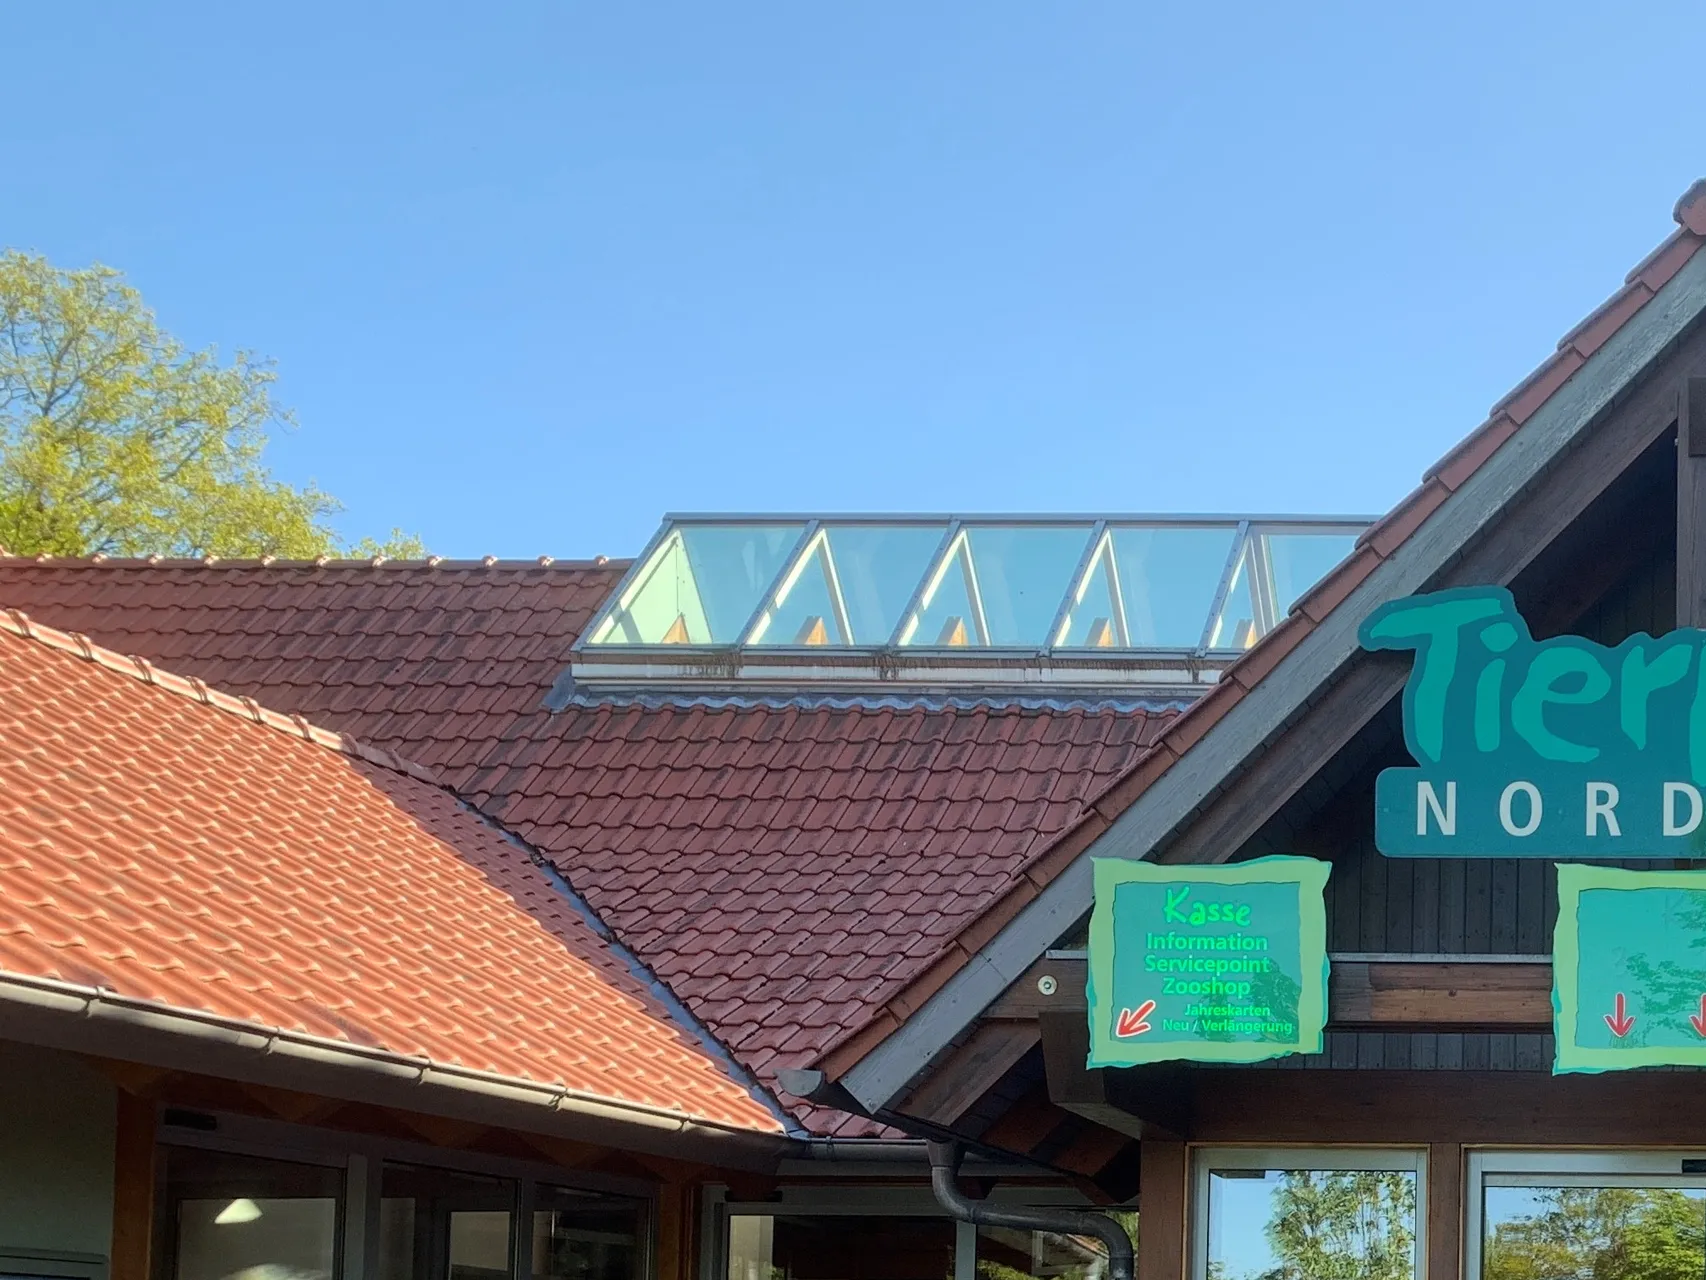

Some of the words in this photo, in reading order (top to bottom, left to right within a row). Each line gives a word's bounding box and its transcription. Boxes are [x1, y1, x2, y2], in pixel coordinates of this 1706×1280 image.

[1163, 886, 1251, 926] Kasse
[1146, 932, 1268, 951] Information
[1144, 954, 1270, 976] Servicepoint
[1162, 977, 1250, 999] Zooshop
[1184, 1003, 1271, 1017] Jahreskarten
[1162, 1019, 1189, 1031] Neu
[1192, 1019, 1199, 1033] /
[1201, 1019, 1293, 1034] Verlängerung
